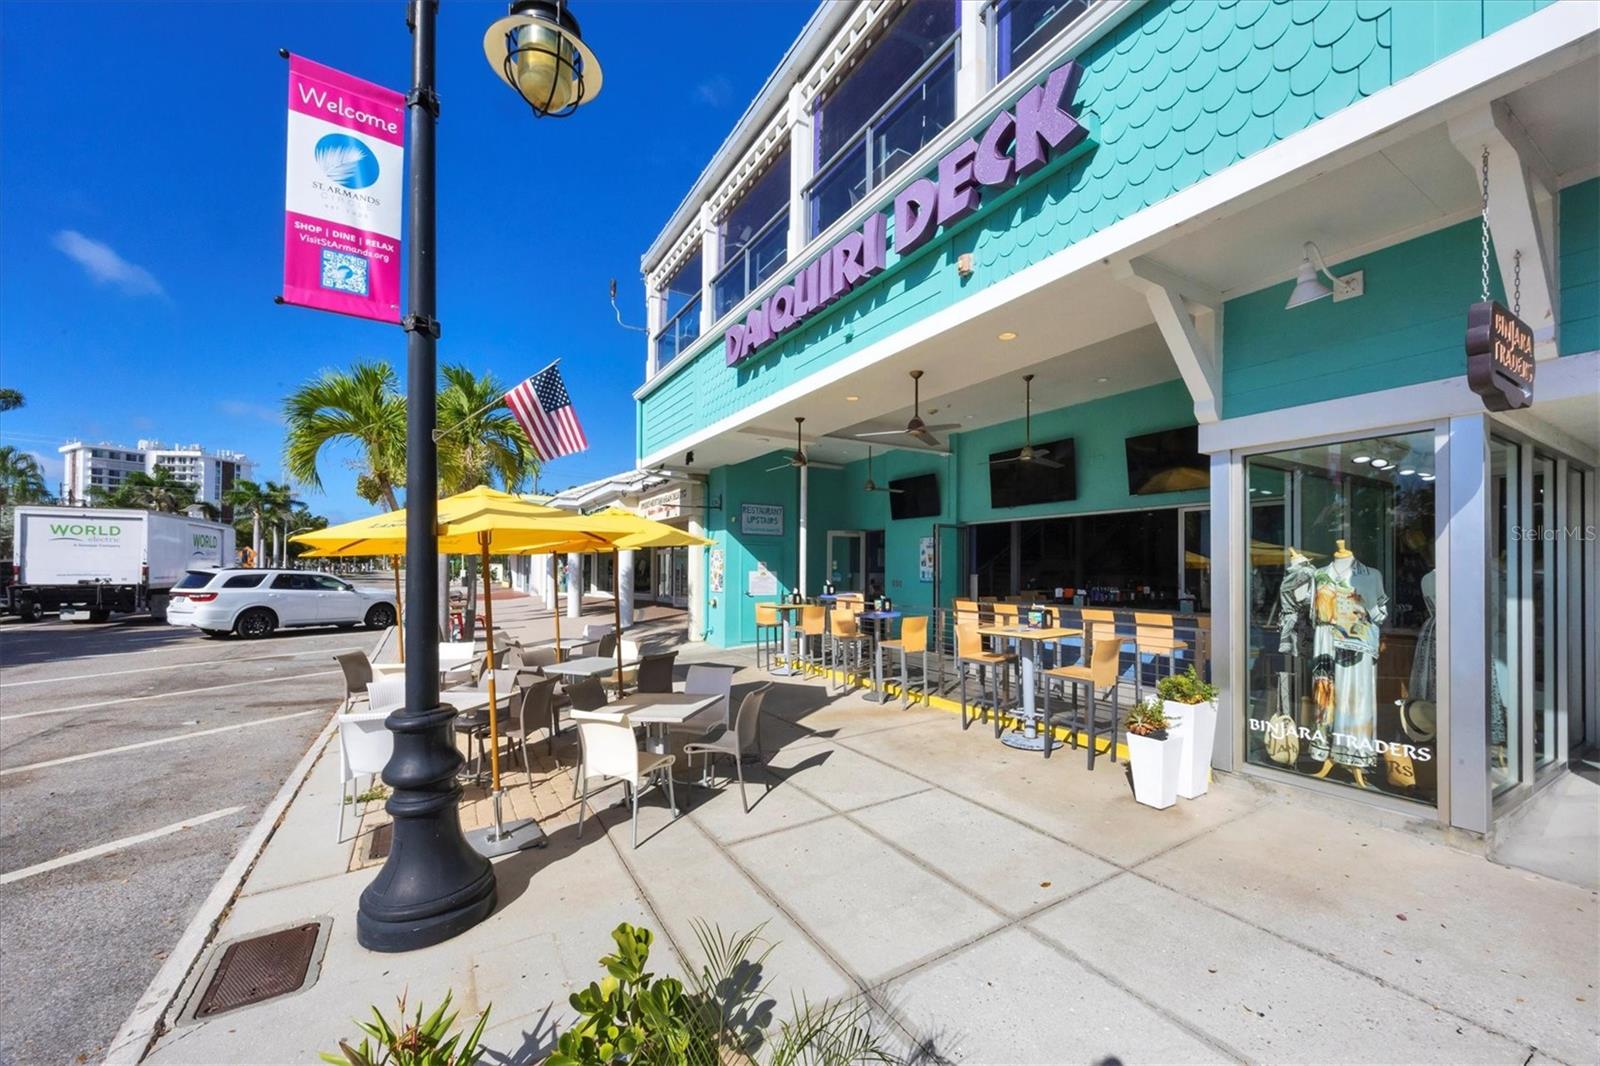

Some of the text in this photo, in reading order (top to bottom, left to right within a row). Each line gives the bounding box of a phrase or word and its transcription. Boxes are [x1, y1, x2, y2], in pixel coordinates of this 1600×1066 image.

[298, 82, 398, 134] Welcome
[327, 185, 381, 206] ARMANDS
[725, 58, 1090, 368] DAIQUIRI DECK
[294, 221, 394, 252] SHOP DINE RELAX
[300, 233, 390, 264] VisitStArmands.org
[50, 524, 121, 536] WORLD
[192, 533, 218, 549] WORLD
[1249, 718, 1432, 762] BINJARA TRADERS
